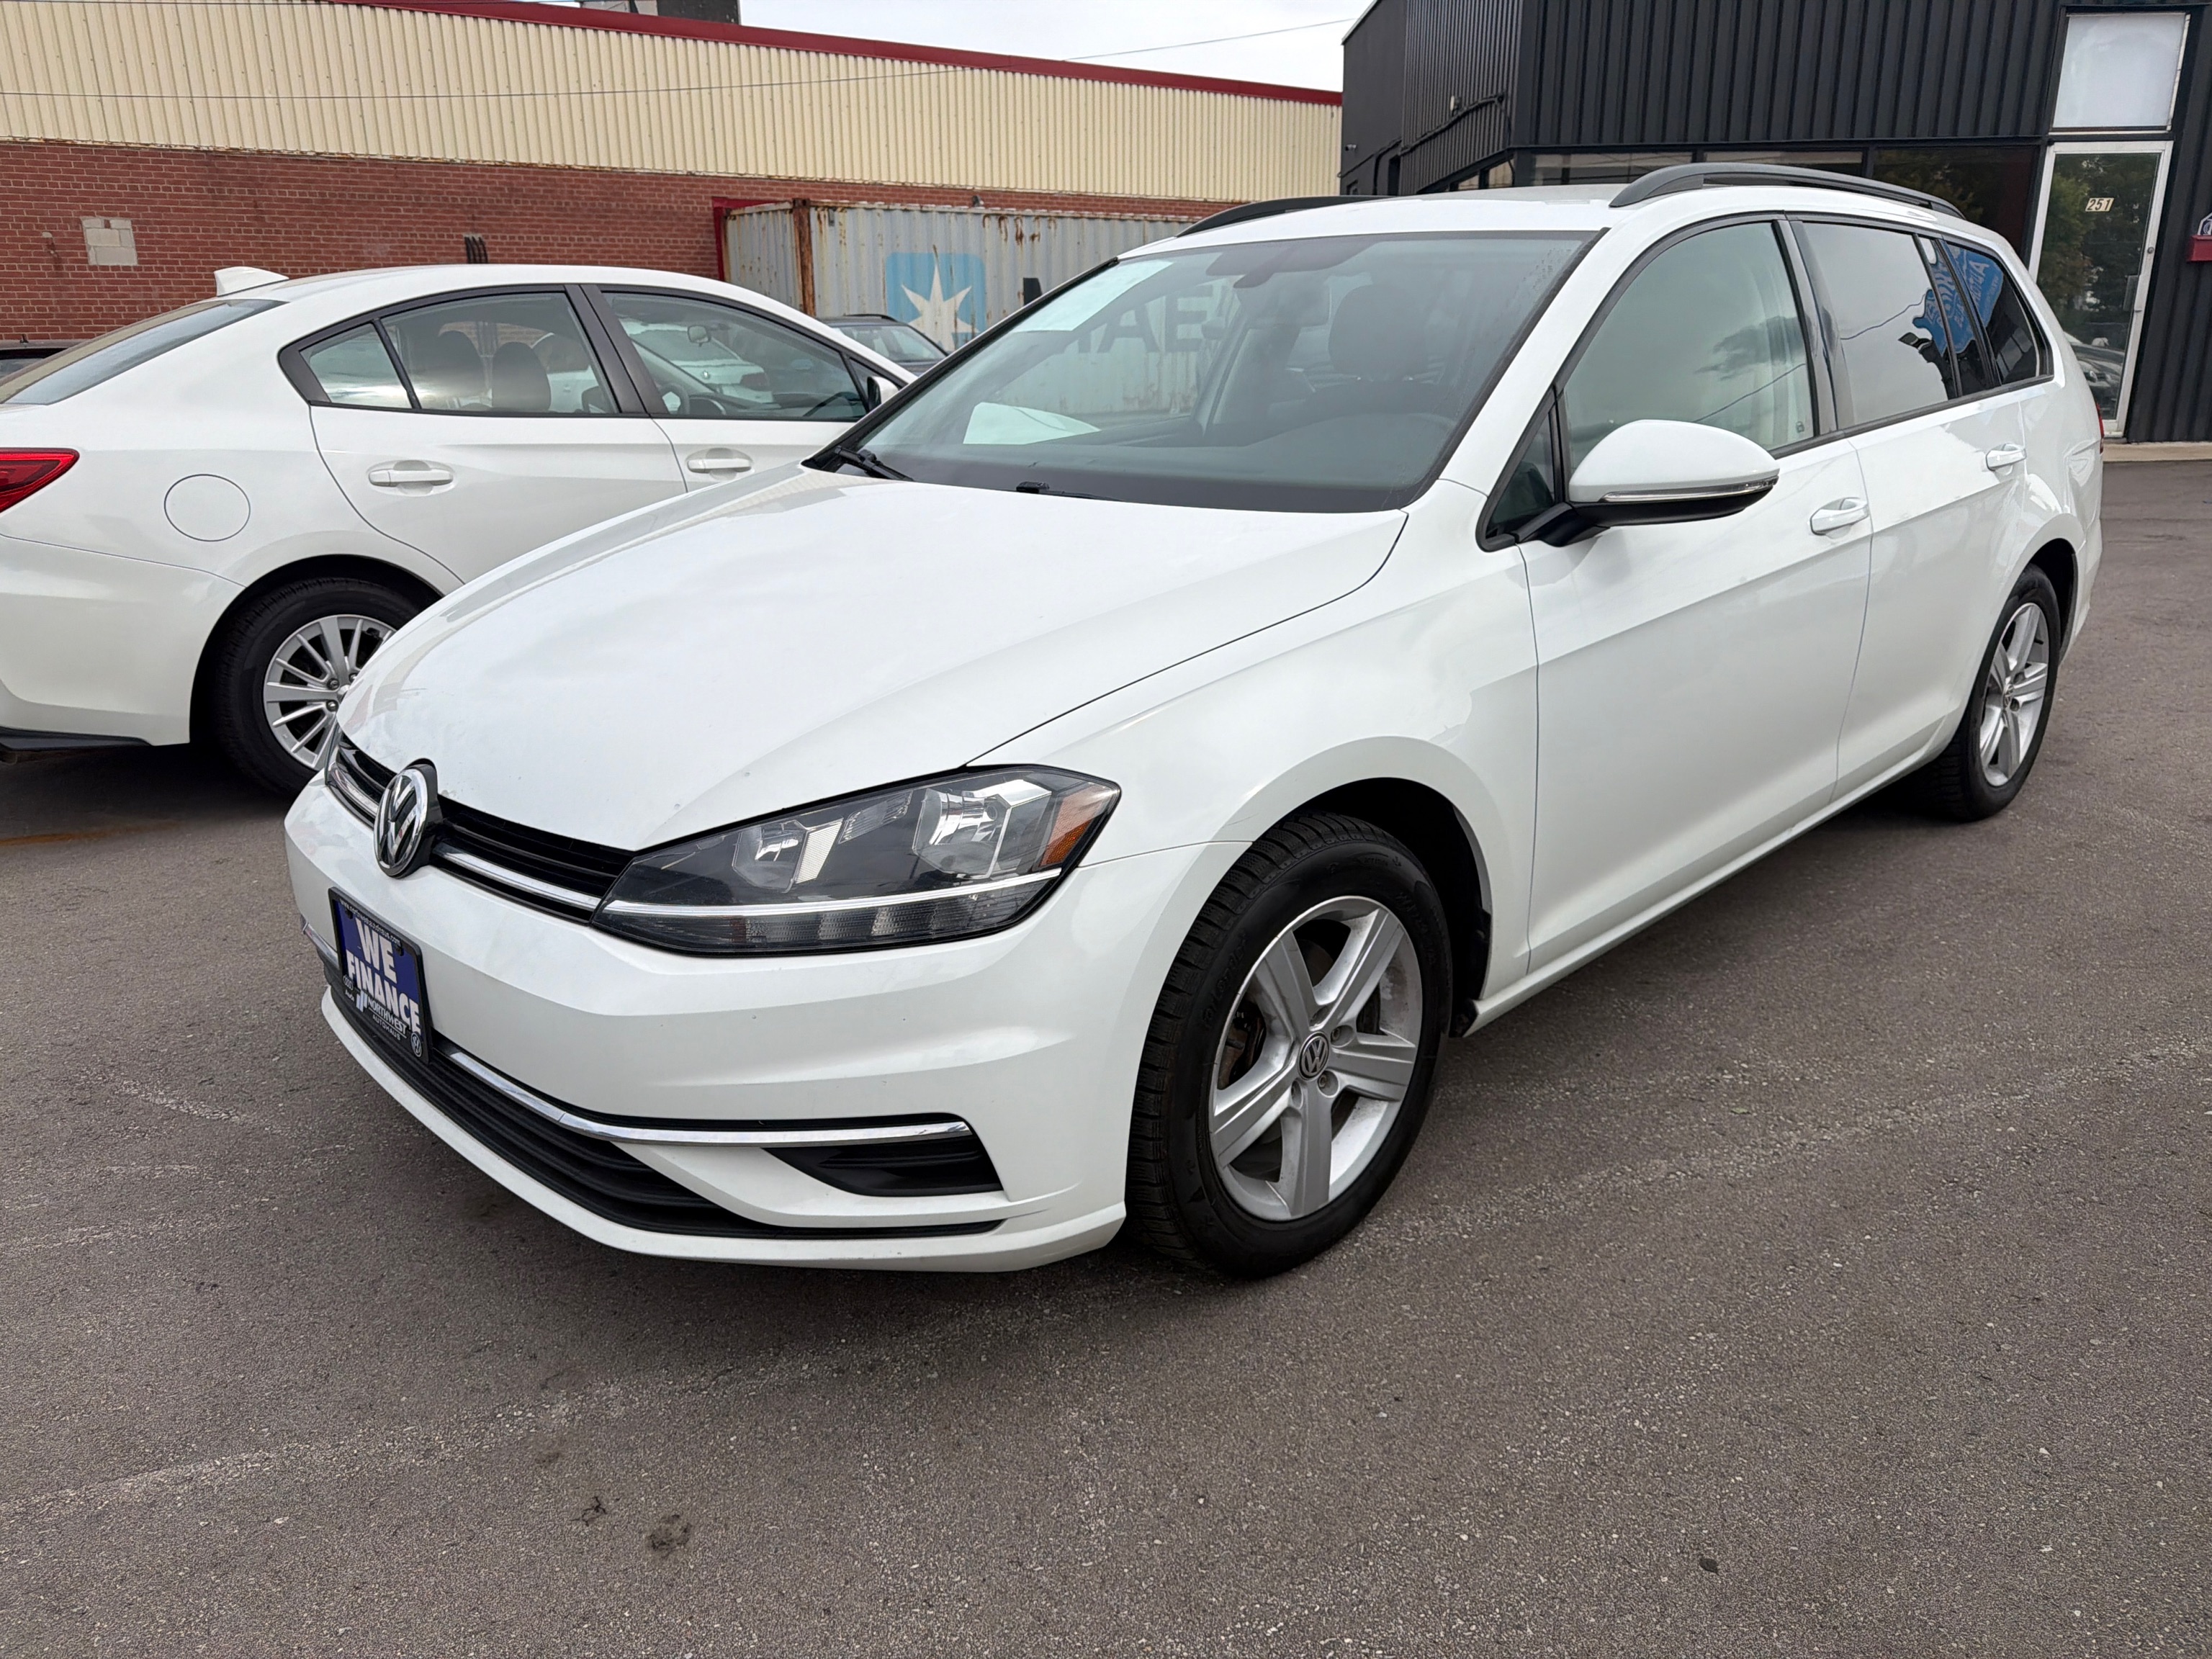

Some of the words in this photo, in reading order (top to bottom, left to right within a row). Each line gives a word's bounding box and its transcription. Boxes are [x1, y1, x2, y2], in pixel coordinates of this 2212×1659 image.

[2087, 198, 2111, 211] 251
[355, 917, 397, 984] WE
[346, 949, 421, 1035] FINANCE
[368, 996, 408, 1035] NORTHWEST
[372, 1014, 401, 1041] AUTOHAUS
